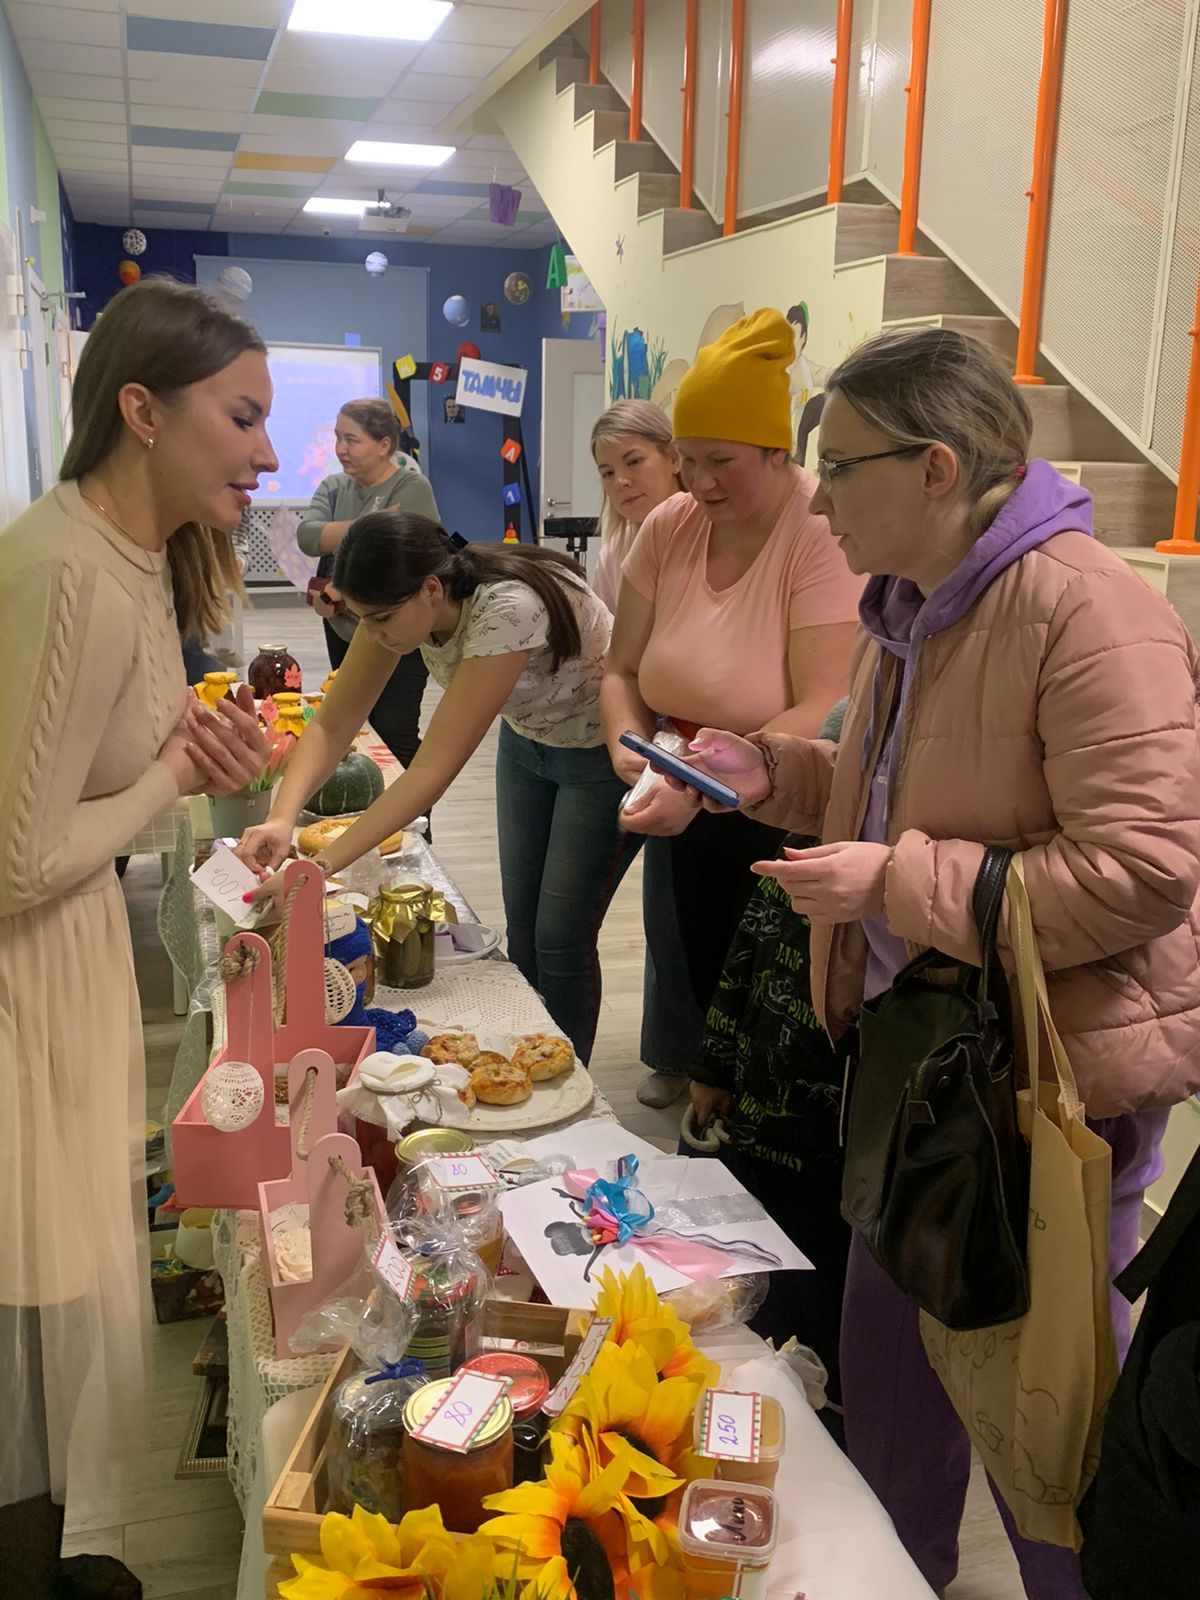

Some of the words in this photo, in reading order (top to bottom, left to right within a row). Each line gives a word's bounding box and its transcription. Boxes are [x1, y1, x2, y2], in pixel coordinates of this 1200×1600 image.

[432, 366, 443, 382] 5
[443, 1400, 473, 1429] 80
[717, 1414, 739, 1446] 250
